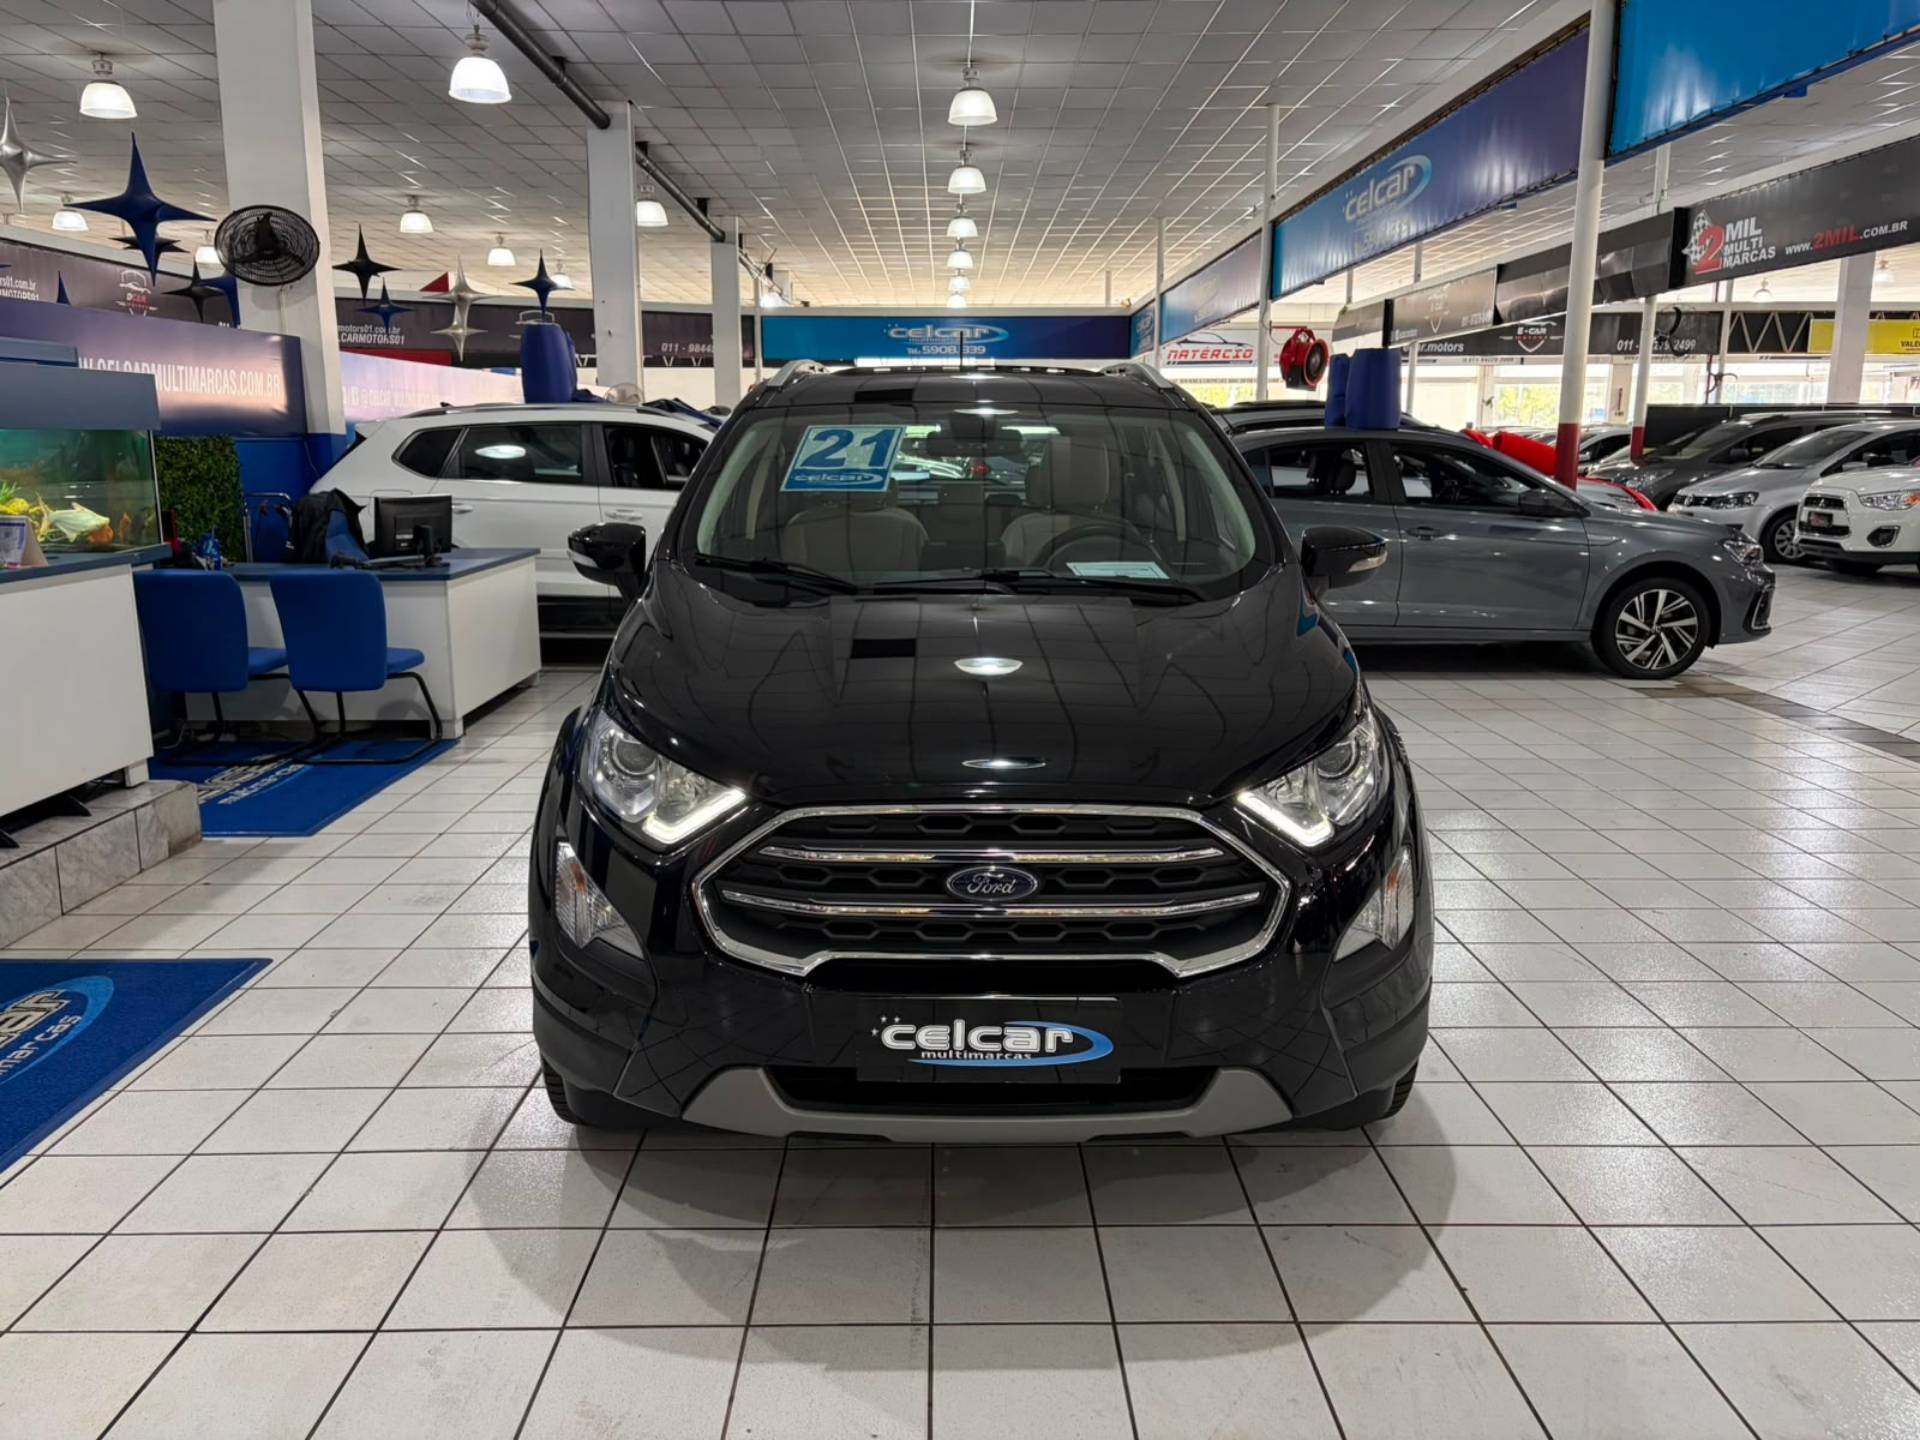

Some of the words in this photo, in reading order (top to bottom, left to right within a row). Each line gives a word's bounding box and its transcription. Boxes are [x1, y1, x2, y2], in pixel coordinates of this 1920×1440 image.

[1345, 164, 1416, 223] celcar
[1726, 216, 1762, 242] MIL
[1722, 246, 1777, 268] MARCAS
[1724, 236, 1763, 256] MULTI
[889, 324, 989, 339] celcar
[1616, 339, 1635, 351] 011
[801, 429, 897, 467] 21
[967, 873, 1018, 895] Ford
[881, 1018, 1074, 1053] celcar
[920, 1049, 1033, 1061] multimarcas
